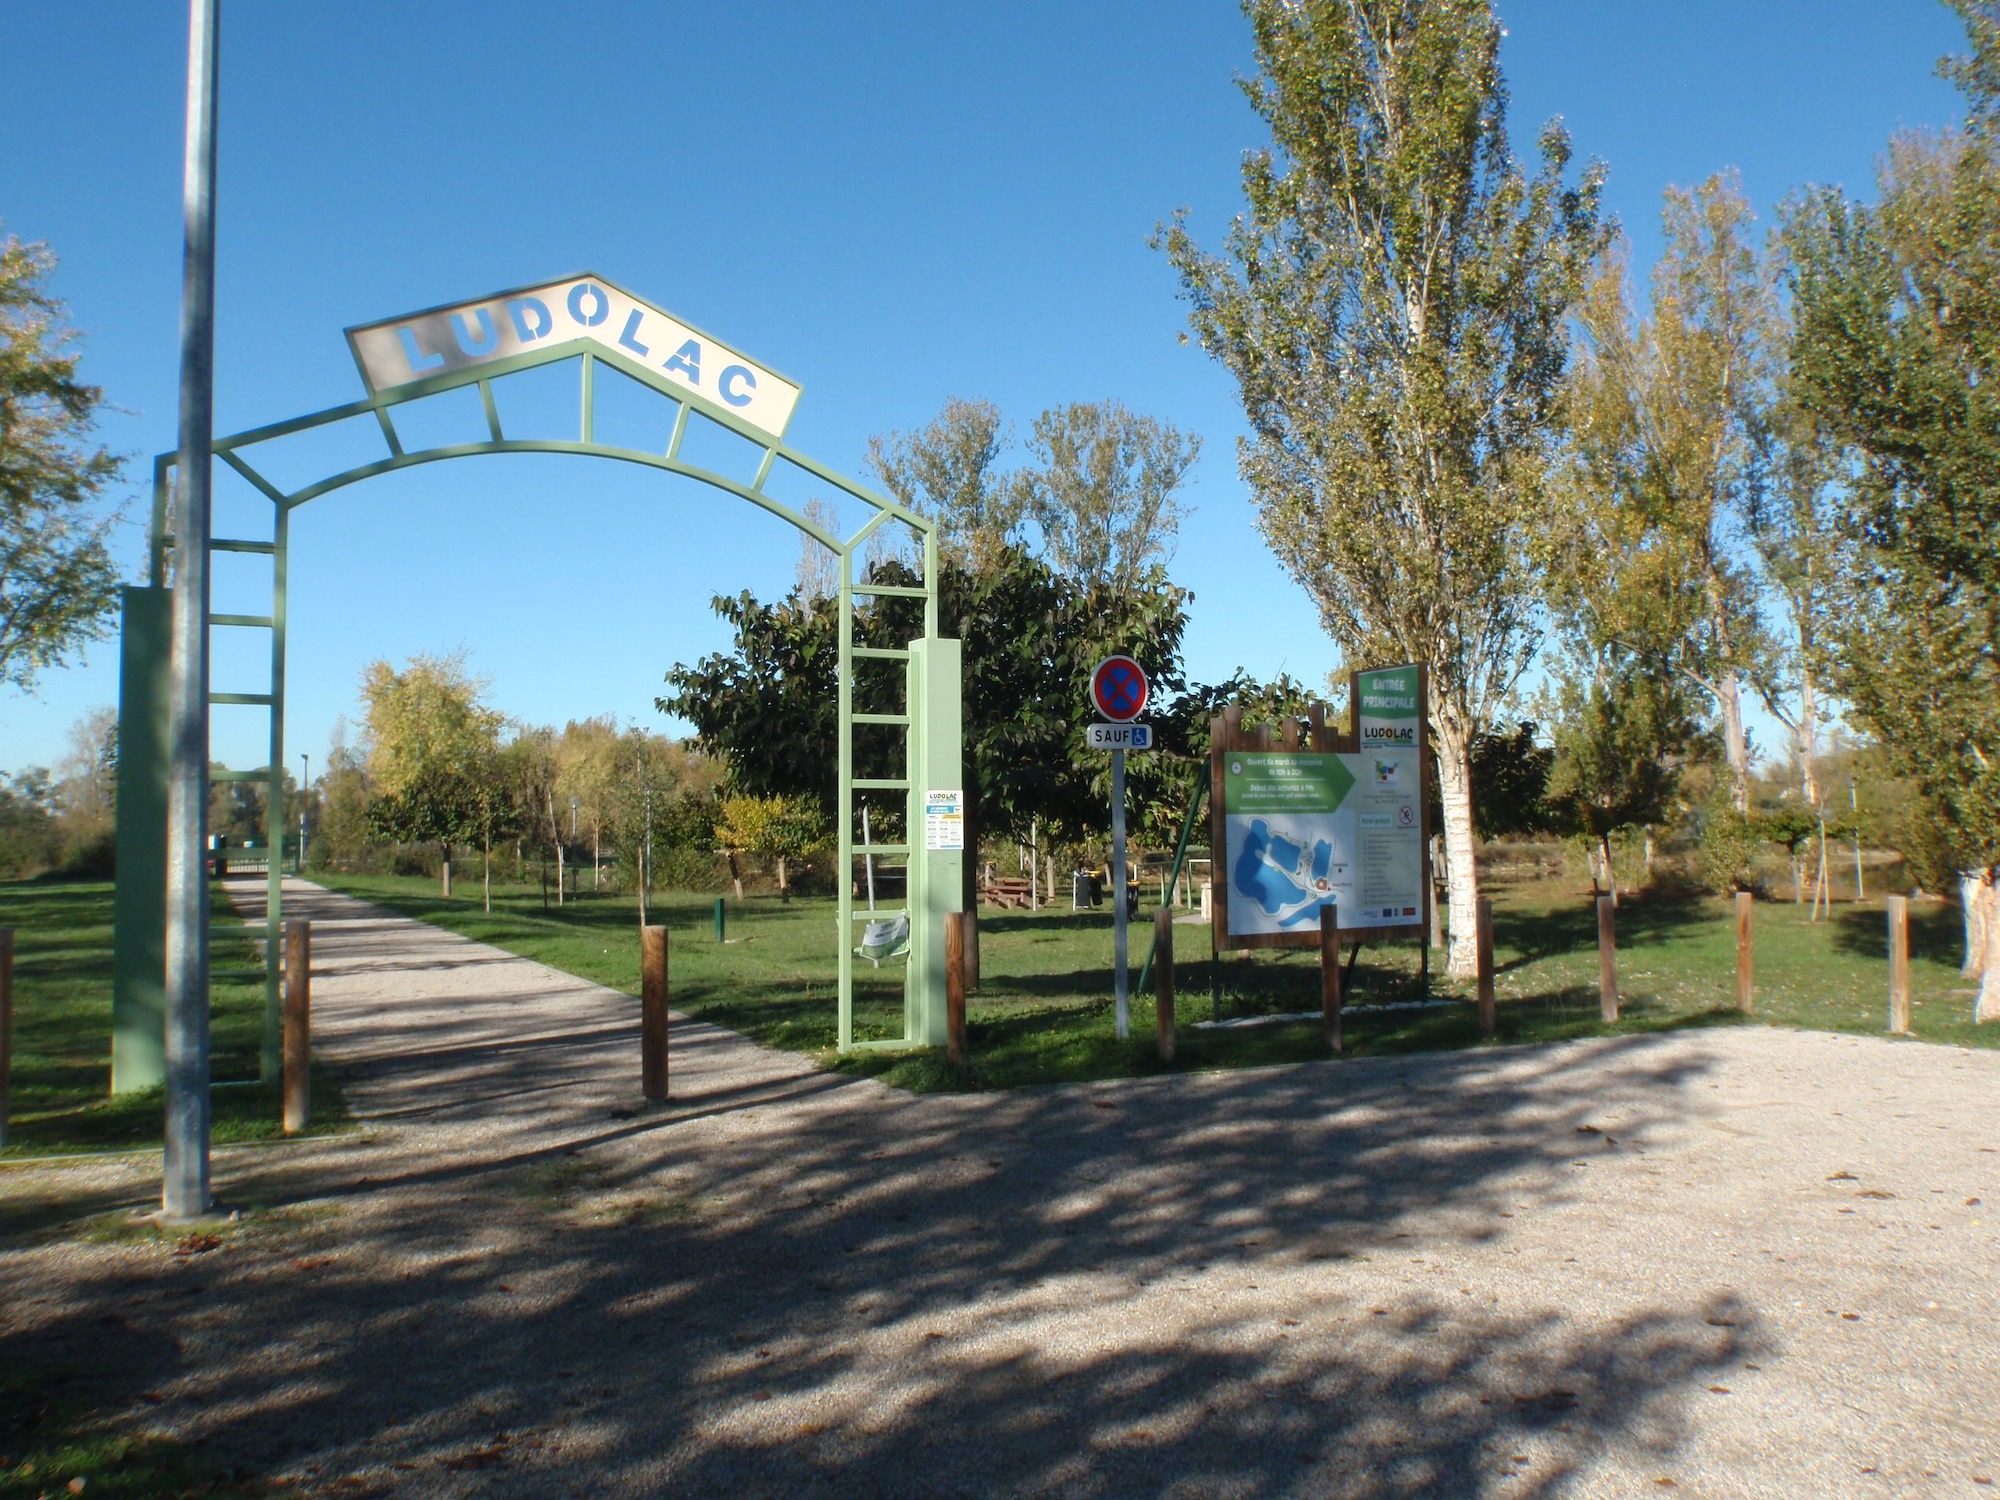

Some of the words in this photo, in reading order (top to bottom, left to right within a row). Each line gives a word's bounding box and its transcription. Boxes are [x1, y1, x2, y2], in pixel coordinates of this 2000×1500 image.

[397, 283, 757, 407] LUDOLAC
[1372, 678, 1406, 691] ENTRÉE
[1362, 695, 1416, 709] PRINCIPALE
[1095, 730, 1130, 742] SAUF
[1364, 727, 1414, 739] LUDOLAC
